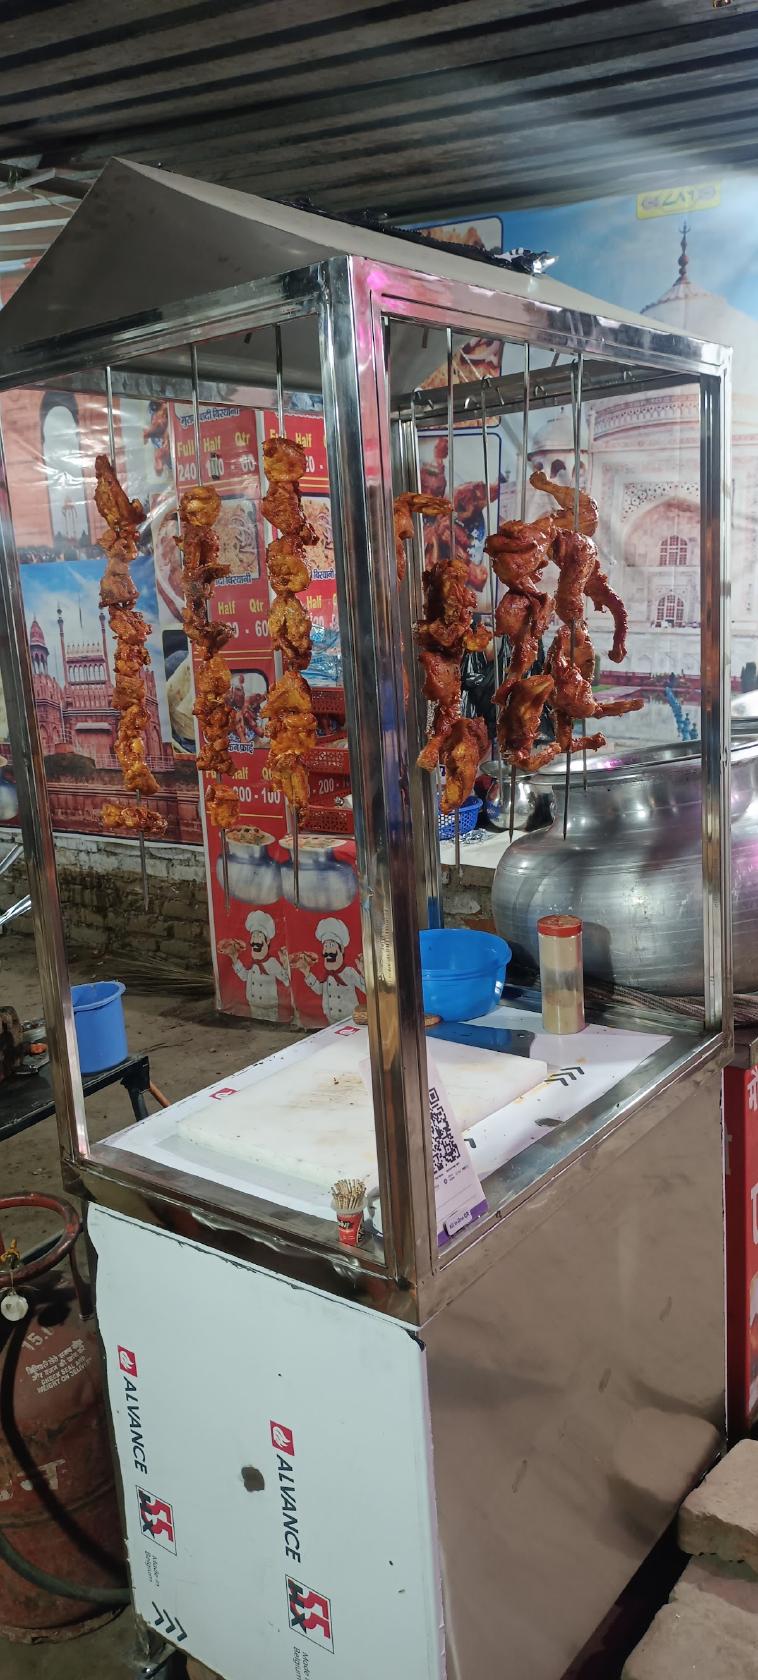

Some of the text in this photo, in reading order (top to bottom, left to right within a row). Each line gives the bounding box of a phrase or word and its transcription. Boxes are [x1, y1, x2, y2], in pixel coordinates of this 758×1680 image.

[177, 439, 194, 457] Full
[203, 435, 221, 453] Half
[235, 432, 251, 447] Qtr
[296, 432, 312, 447] Half
[177, 462, 196, 481] 240
[218, 599, 264, 614] Half Qtr
[307, 596, 322, 609] Half
[255, 620, 269, 637] 60
[319, 778, 334, 795] 200
[37, 1379, 61, 1393] WEIGHT
[61, 1373, 70, 1382] ON
[41, 1371, 61, 1386] CHECK
[60, 1364, 75, 1375] SEAL
[123, 1375, 148, 1474] ALVANCE
[275, 1453, 301, 1563] ALVANCE
[145, 1550, 153, 1582] Belgium
[152, 1555, 160, 1578] Made
[290, 1590, 331, 1639] 55
[303, 1651, 312, 1677] Made
